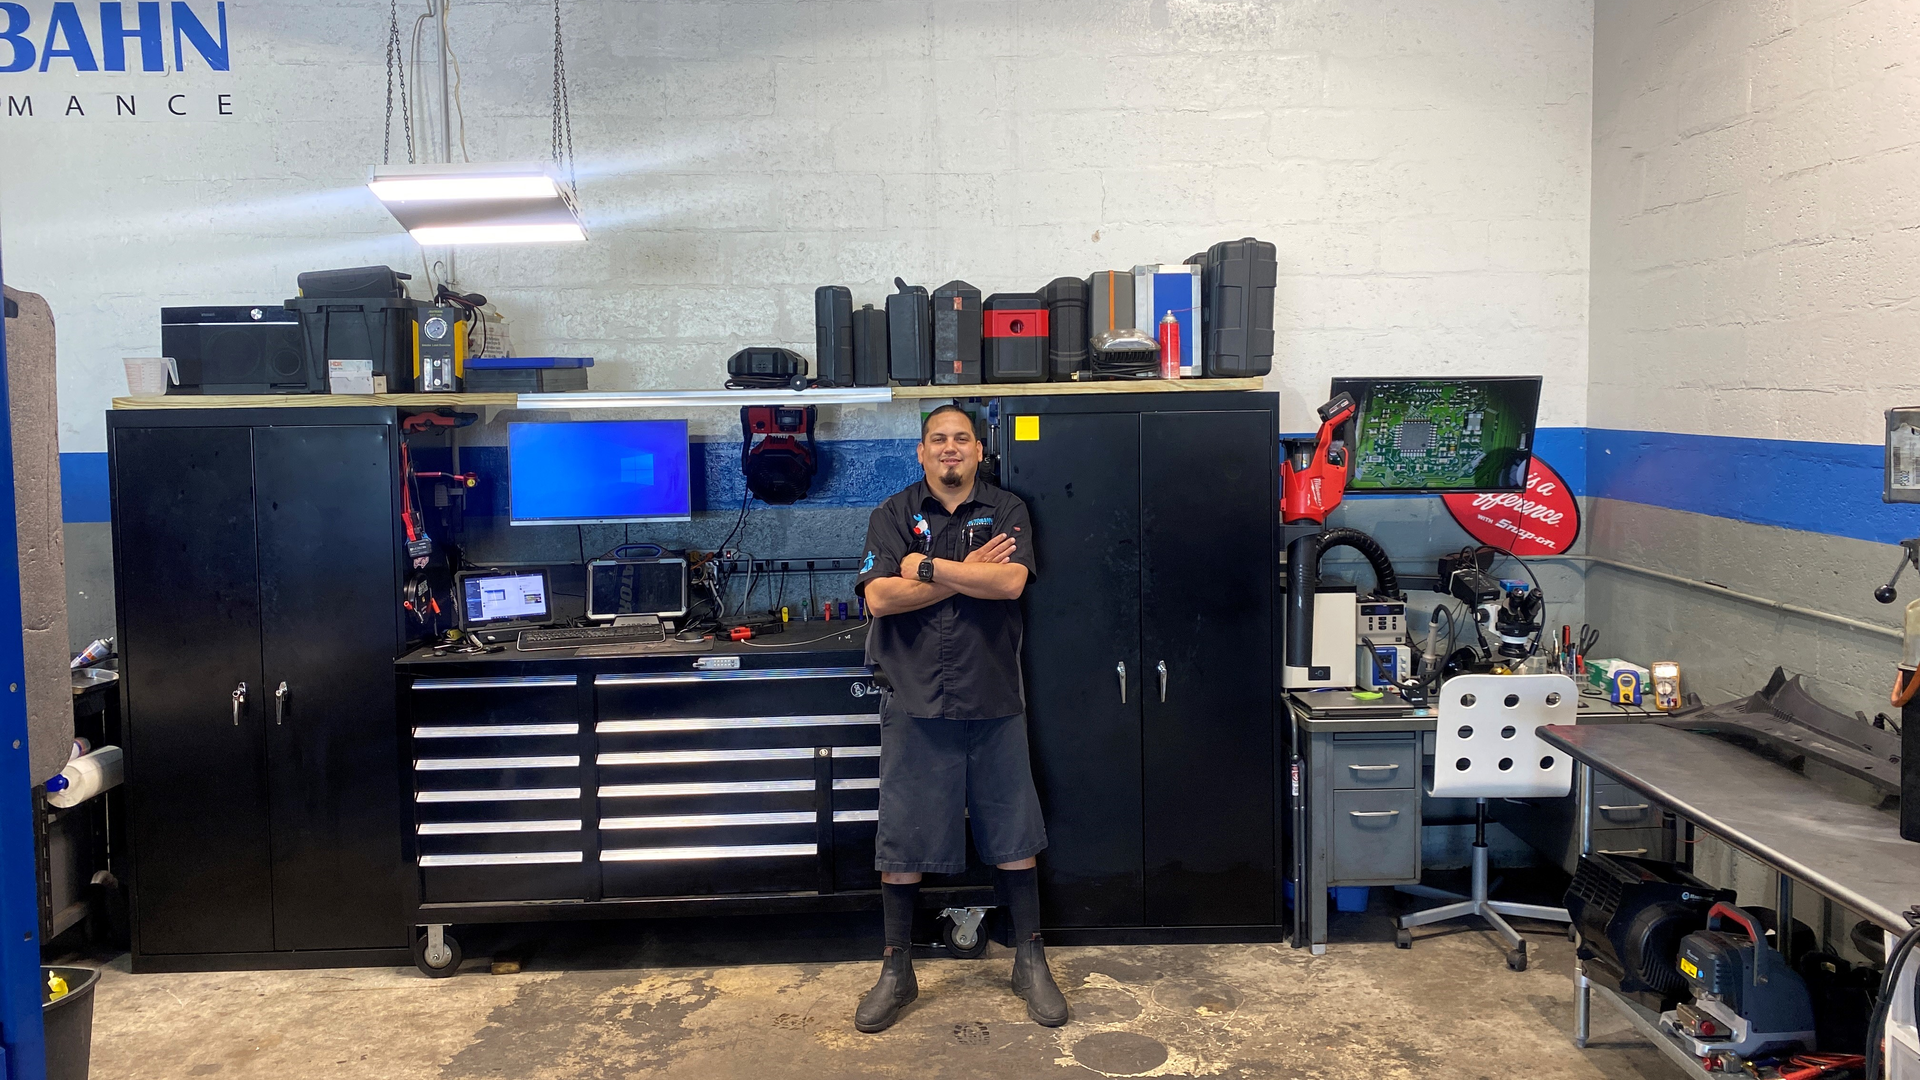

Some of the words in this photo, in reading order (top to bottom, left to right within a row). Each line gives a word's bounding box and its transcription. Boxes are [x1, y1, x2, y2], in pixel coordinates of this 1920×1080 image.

[0, 1, 230, 73] BAHN
[0, 94, 233, 117] MANCE
[1537, 482, 1556, 496] a
[1494, 518, 1557, 549] Snap-on
